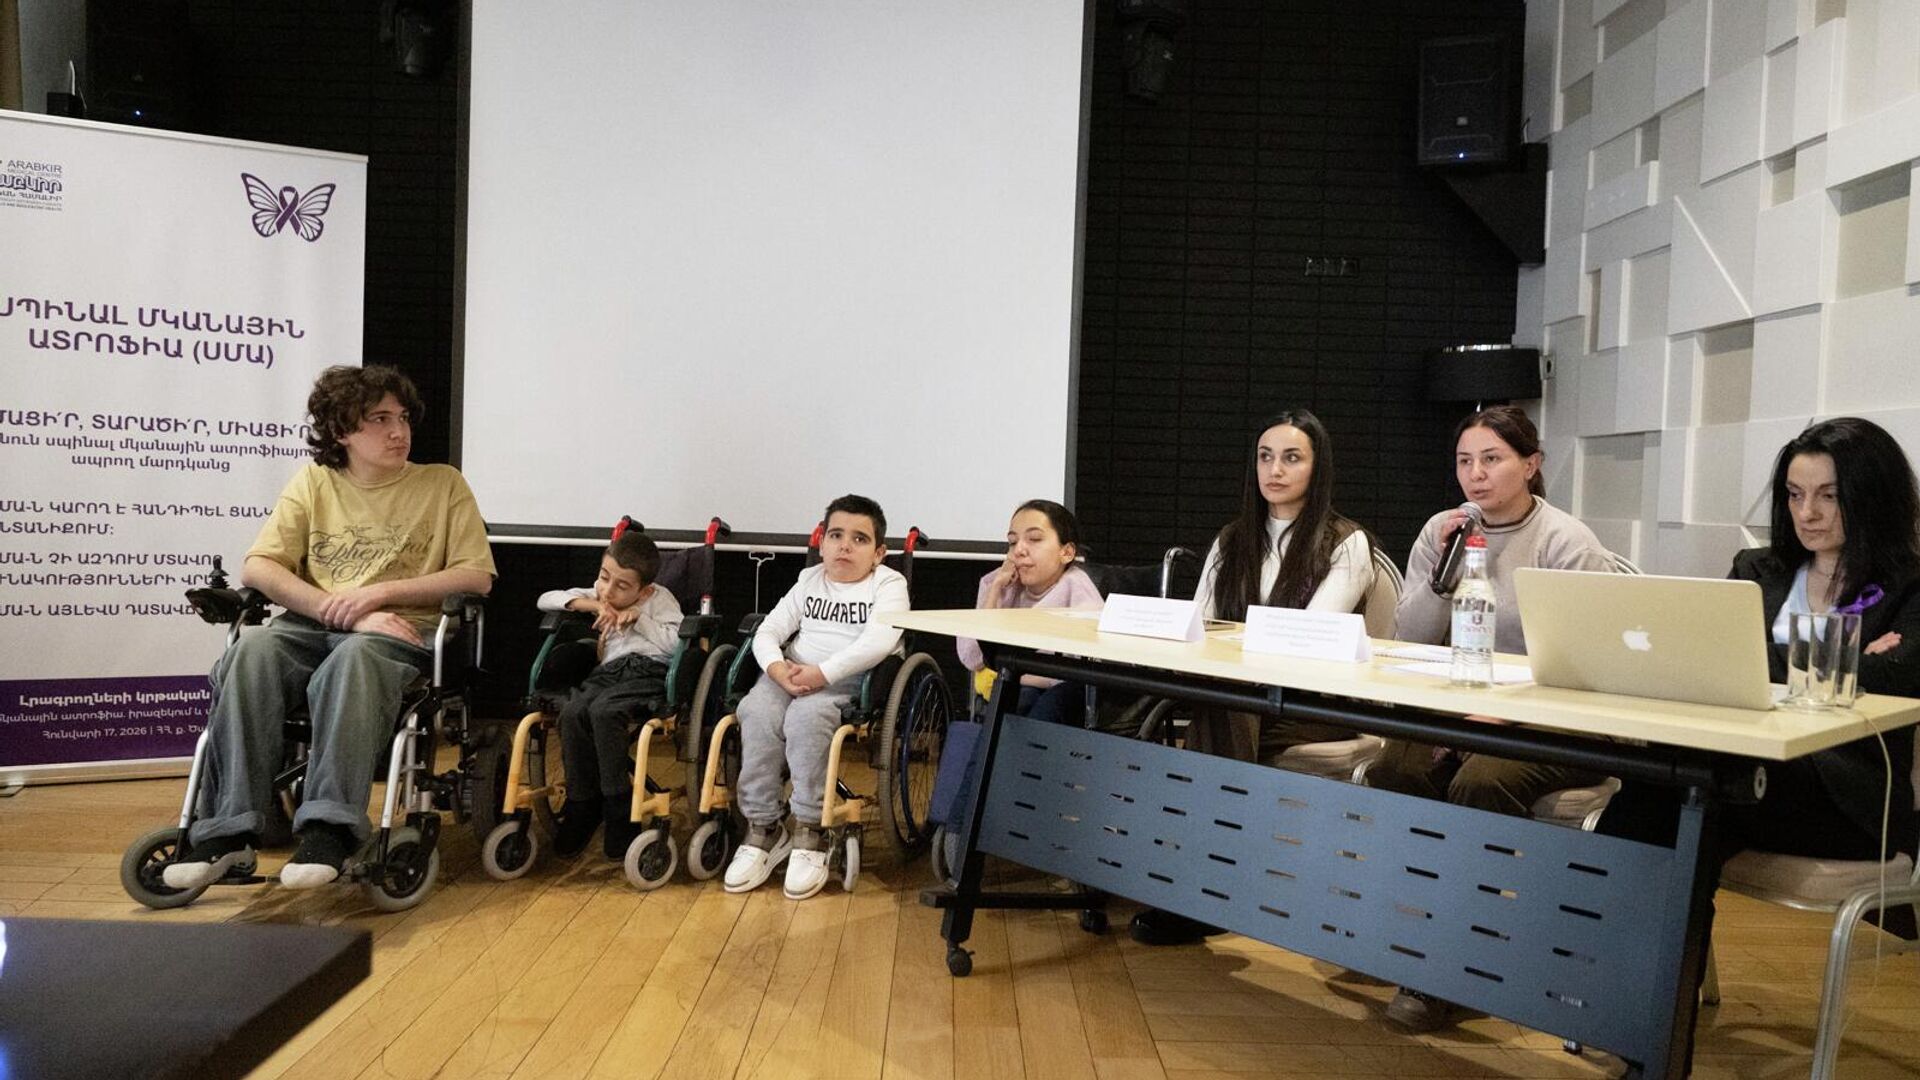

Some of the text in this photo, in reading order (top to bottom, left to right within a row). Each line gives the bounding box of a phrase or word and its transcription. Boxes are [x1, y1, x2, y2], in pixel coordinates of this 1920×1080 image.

[7, 159, 62, 173] ARABKIR
[138, 307, 305, 339] ՄԿԱՆԱՅԻՆ
[29, 328, 274, 369] ԱՏՐՈՖԻԱ (ՍՄԱ)
[46, 435, 115, 451] սպինալ
[119, 437, 205, 455] մկանային
[72, 454, 230, 473] ապրող մարդկանց
[50, 501, 111, 514] ԿԱՐՈՂ
[116, 503, 127, 515] Է
[131, 503, 225, 517] ՀԱՆԴԻՊԵԼ
[48, 552, 72, 565] ՉԻ
[78, 553, 149, 565] ԱԶԴՈՒՄ
[48, 604, 120, 616] ԱՅԼԵՎՍ
[19, 689, 210, 707] Լրագրողների կրթական
[128, 706, 192, 719] իրազեկում
[42, 728, 102, 740] Հունվարի
[119, 726, 147, 736] 2026
